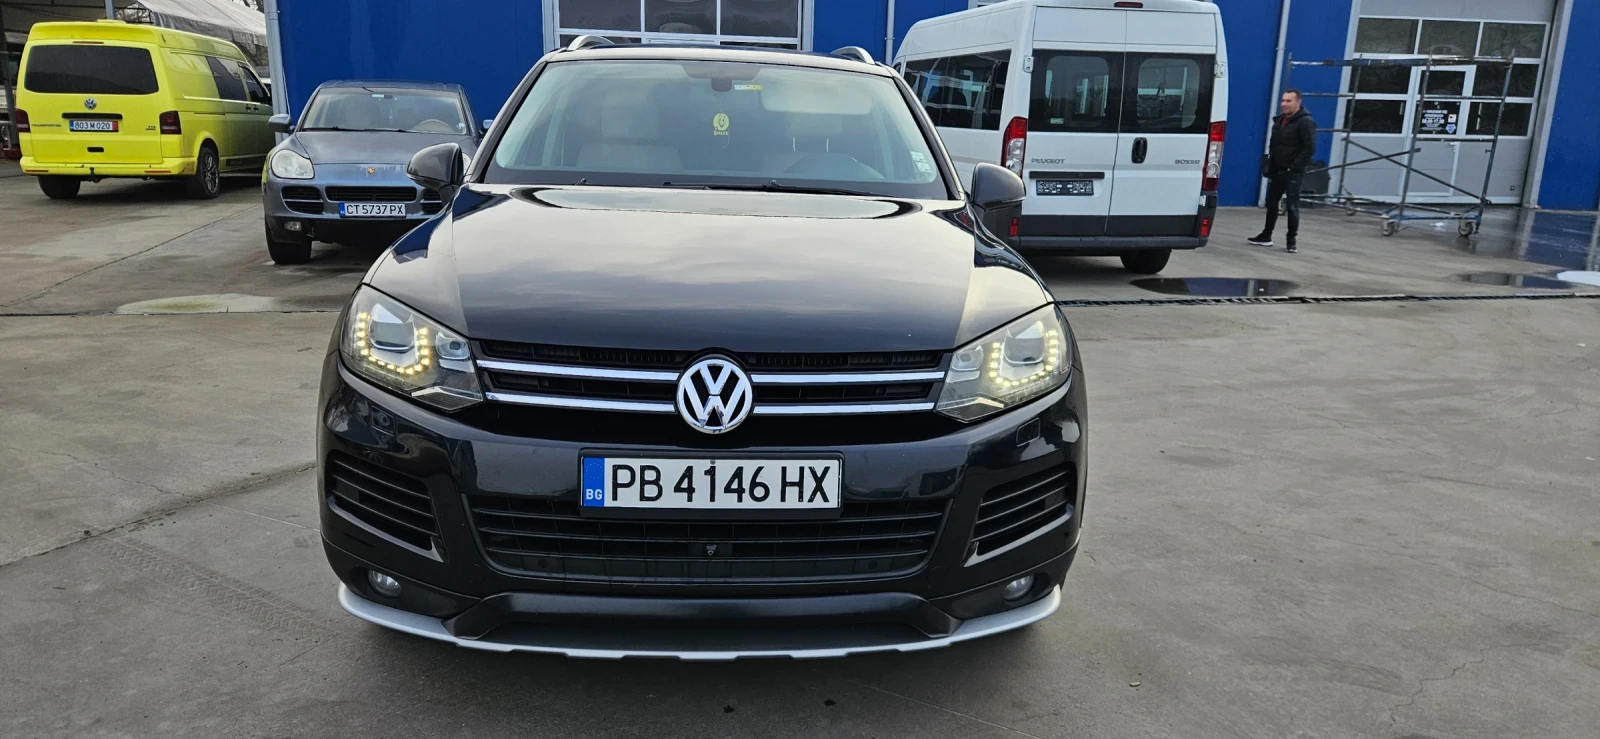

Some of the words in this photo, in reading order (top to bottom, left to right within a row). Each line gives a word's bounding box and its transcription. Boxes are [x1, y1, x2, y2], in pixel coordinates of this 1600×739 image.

[74, 121, 89, 130] 803
[89, 122, 95, 130] M
[96, 122, 111, 130] 020
[346, 204, 360, 215] CT
[362, 204, 388, 215] 5737
[389, 204, 404, 215] PX
[611, 464, 664, 502] PB
[673, 465, 771, 503] 4146
[780, 466, 831, 503] HX
[585, 488, 603, 501] BG
